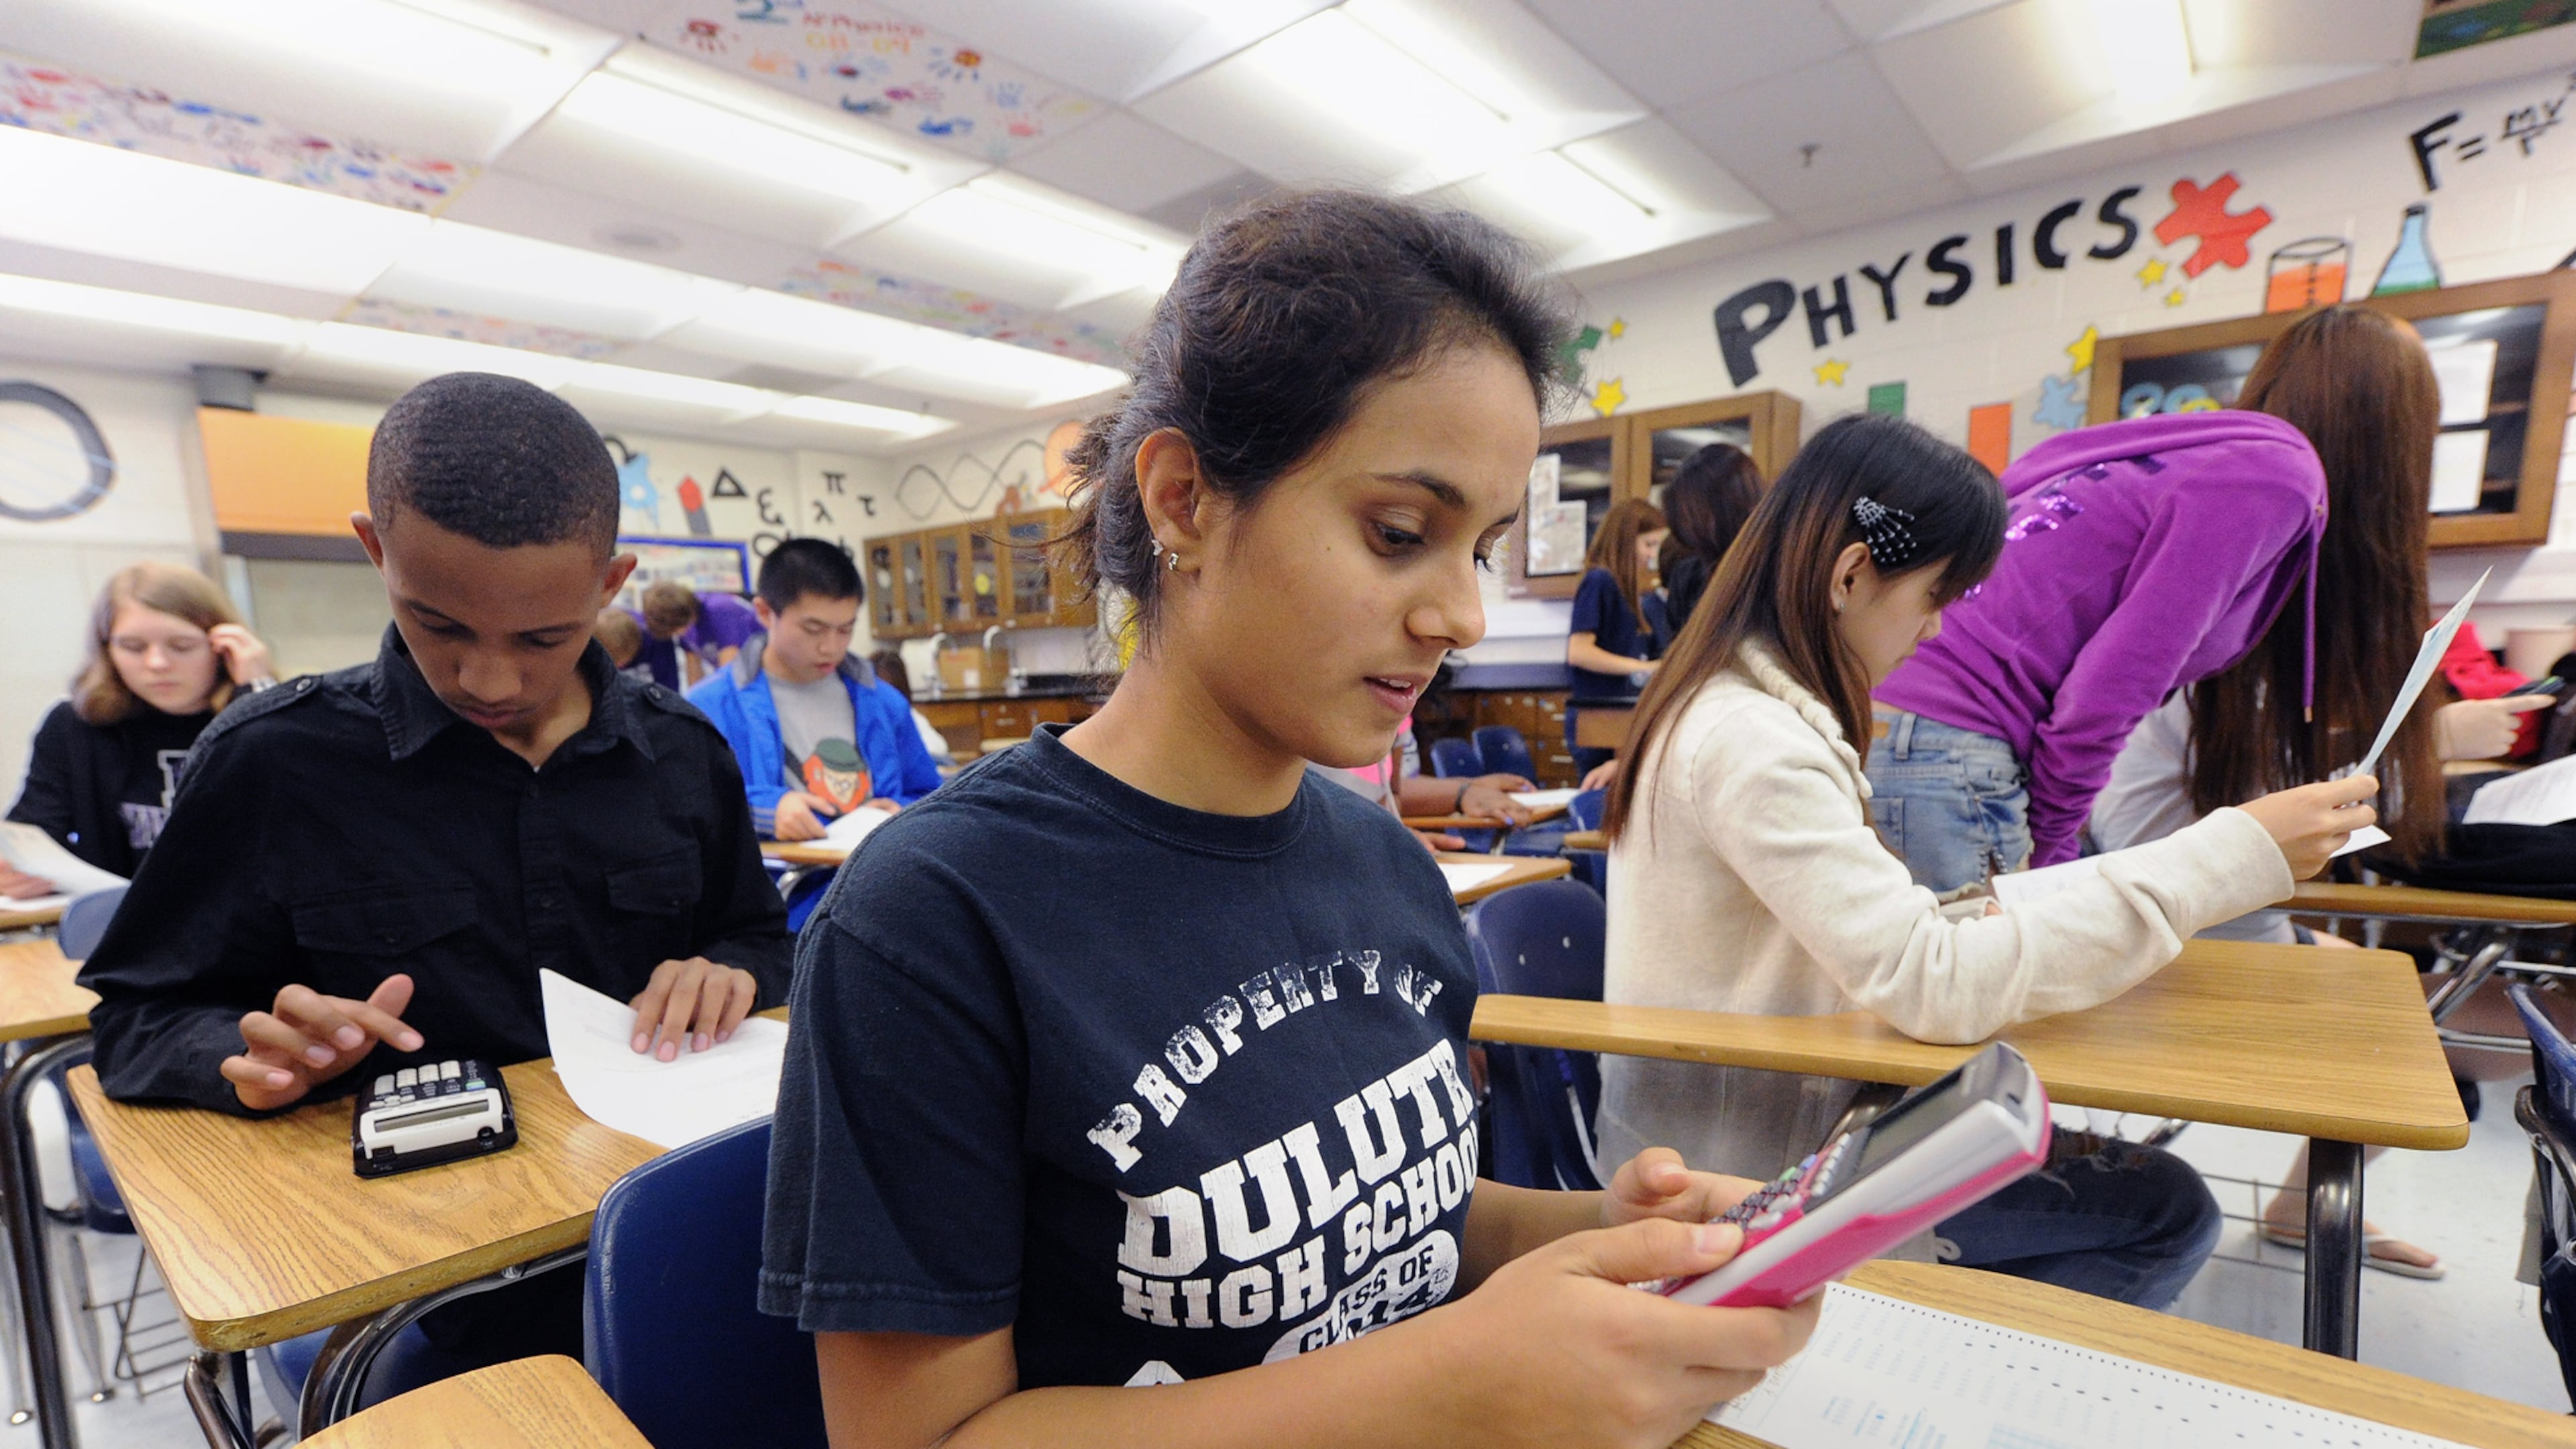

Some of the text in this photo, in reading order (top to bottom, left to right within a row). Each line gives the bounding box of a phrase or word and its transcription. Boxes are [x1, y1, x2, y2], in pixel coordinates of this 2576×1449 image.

[1713, 184, 2145, 388] PHYSICS
[1085, 949, 1382, 1173] PROPERTY
[1117, 1234, 1328, 1330] HIGH
[1399, 1244, 1434, 1287] OF
